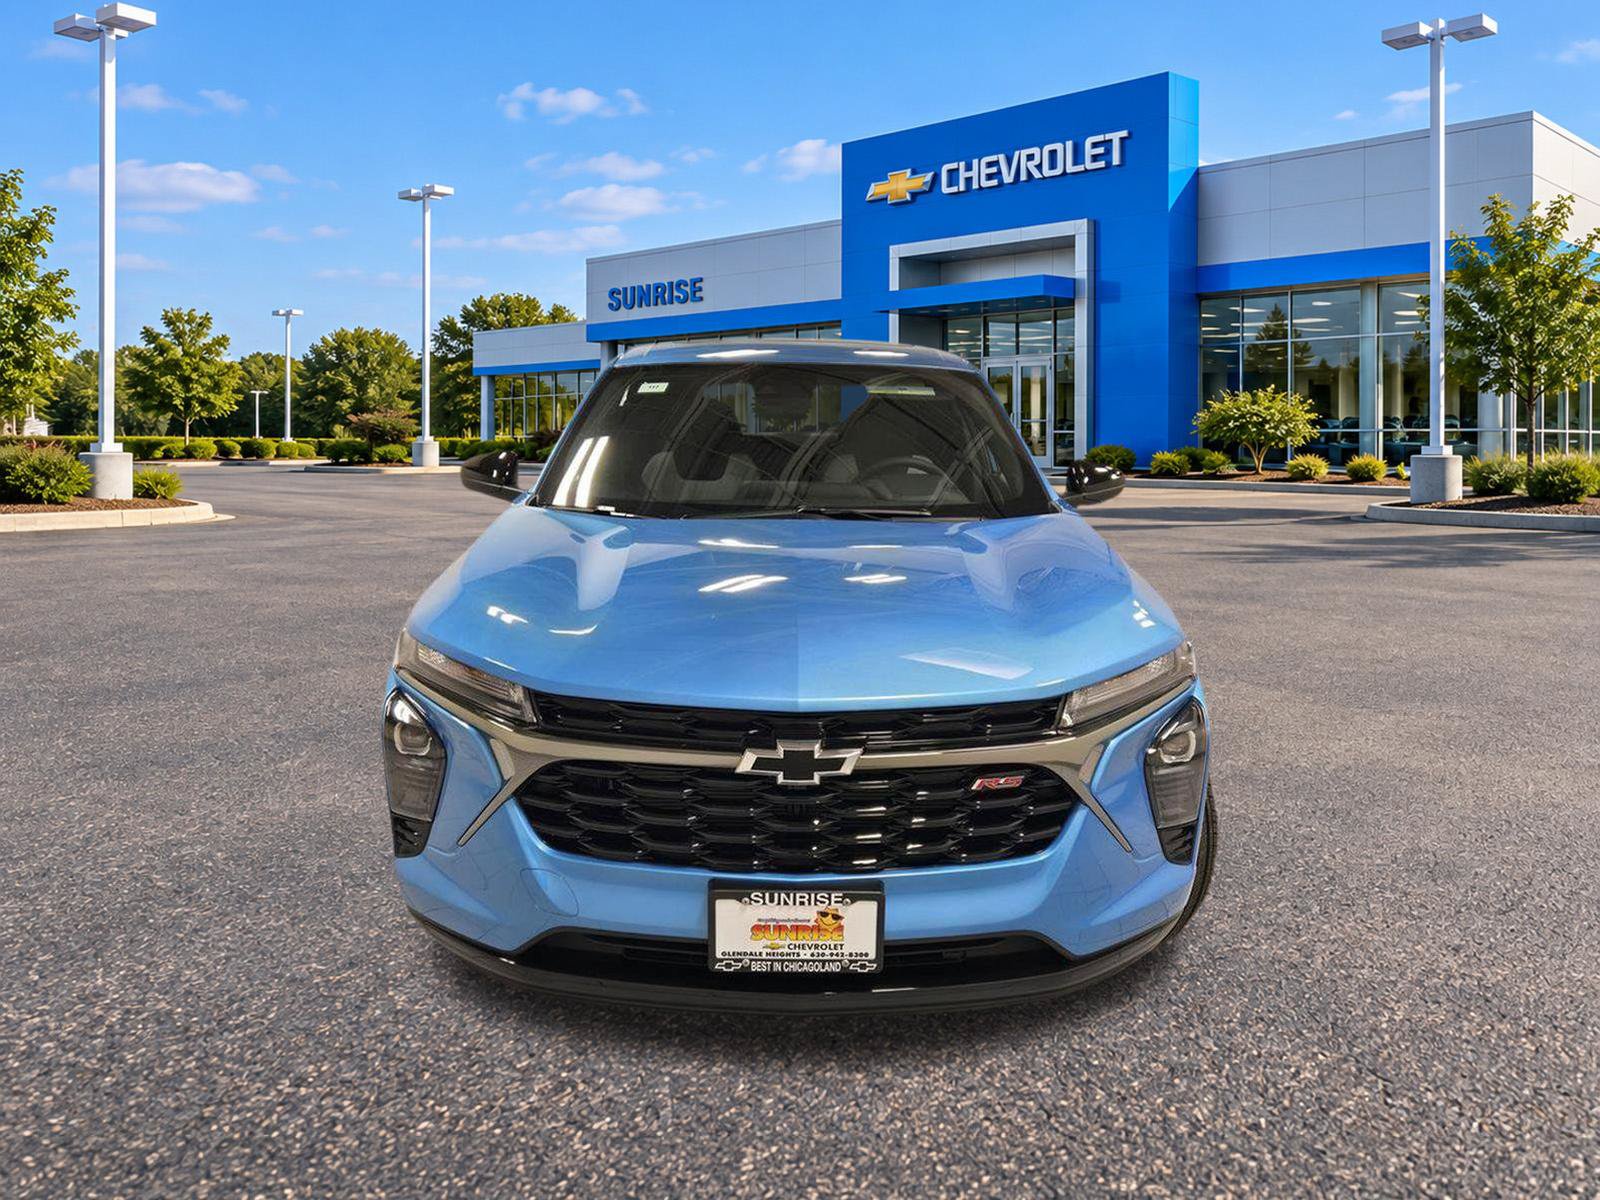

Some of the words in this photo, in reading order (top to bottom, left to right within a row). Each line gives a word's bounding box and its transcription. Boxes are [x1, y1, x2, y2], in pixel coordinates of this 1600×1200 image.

[941, 130, 1129, 194] CHEVROLET
[607, 277, 705, 311] SUNRISE
[971, 776, 1024, 790] RS
[750, 892, 843, 906] SUNRISE
[750, 923, 845, 942] SUNRISE
[787, 943, 845, 951] CHEVROLET
[750, 961, 772, 972] BEST
[773, 961, 782, 972] IN
[783, 961, 842, 972] CHICAGOLAND
